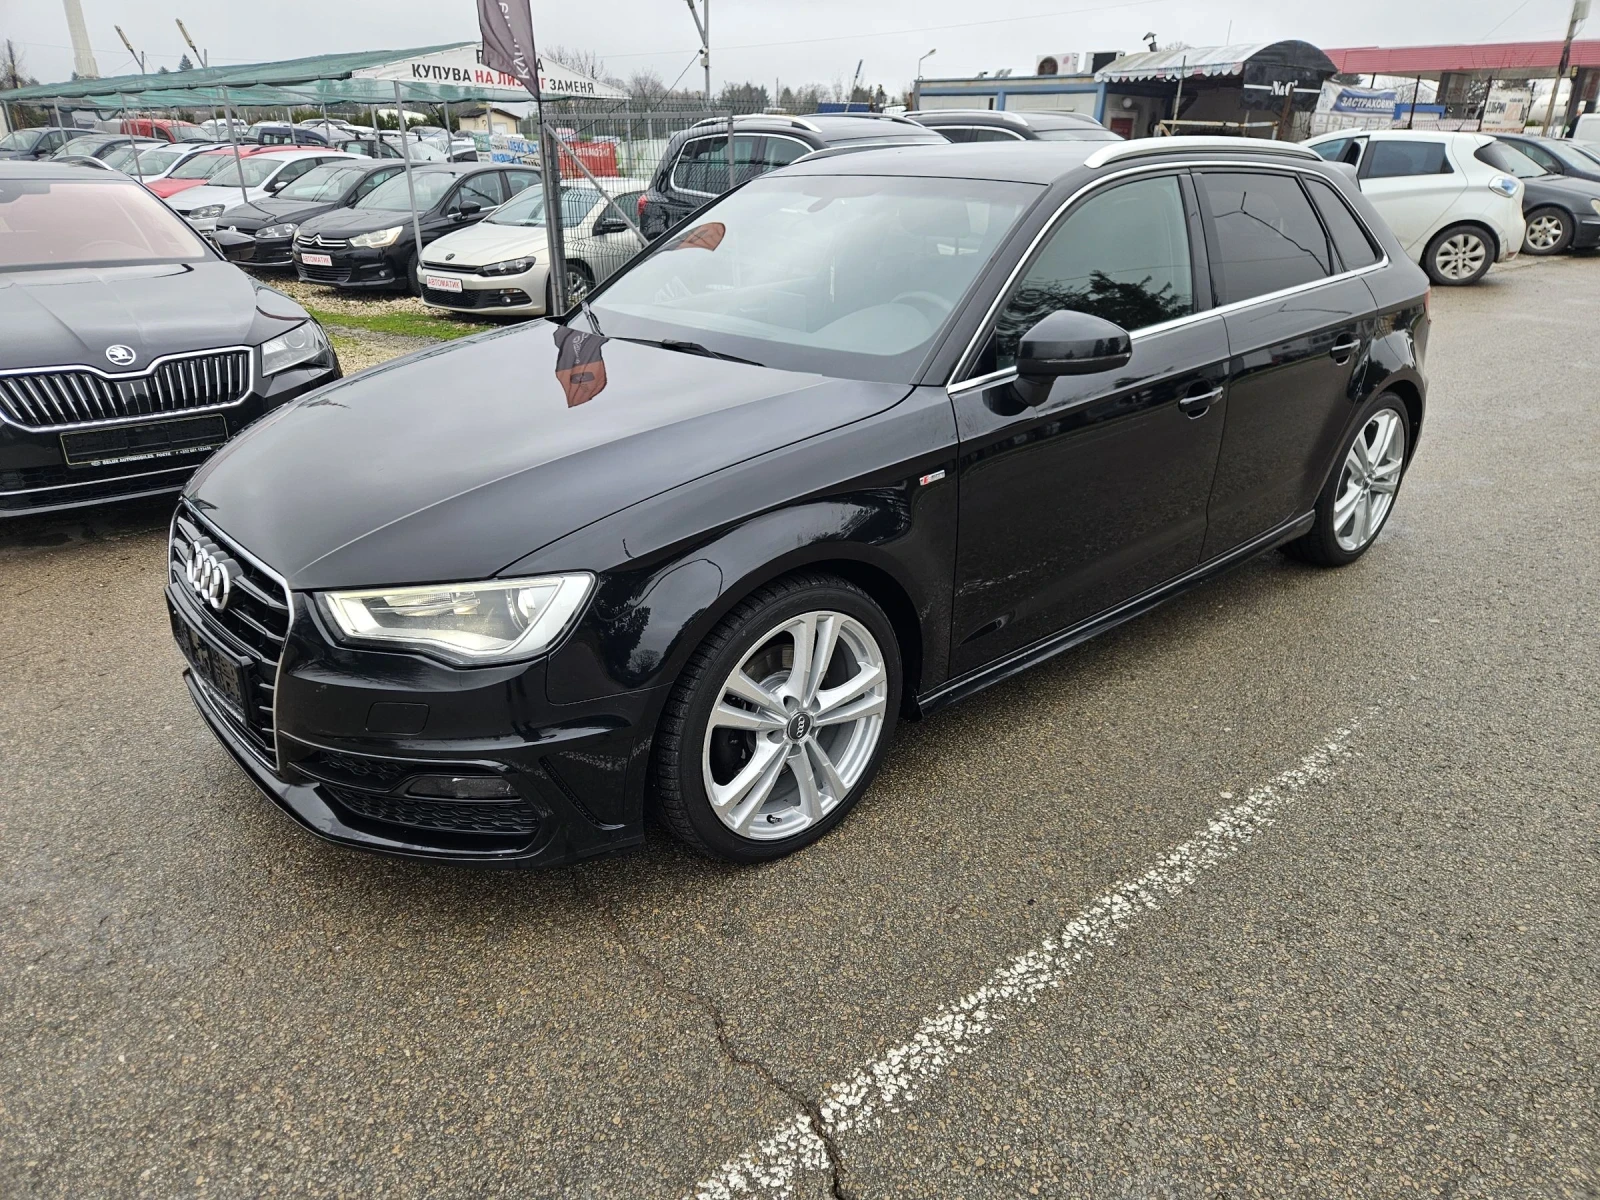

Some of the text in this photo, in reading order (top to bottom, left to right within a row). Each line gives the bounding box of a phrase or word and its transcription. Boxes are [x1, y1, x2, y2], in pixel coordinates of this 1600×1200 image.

[411, 64, 472, 82] КУПУВА
[475, 70, 494, 85] НА
[549, 79, 595, 94] ЗАМЕНЯ
[302, 254, 332, 265] АВТОМАТИК
[427, 277, 461, 290] АВТОМАТИК
